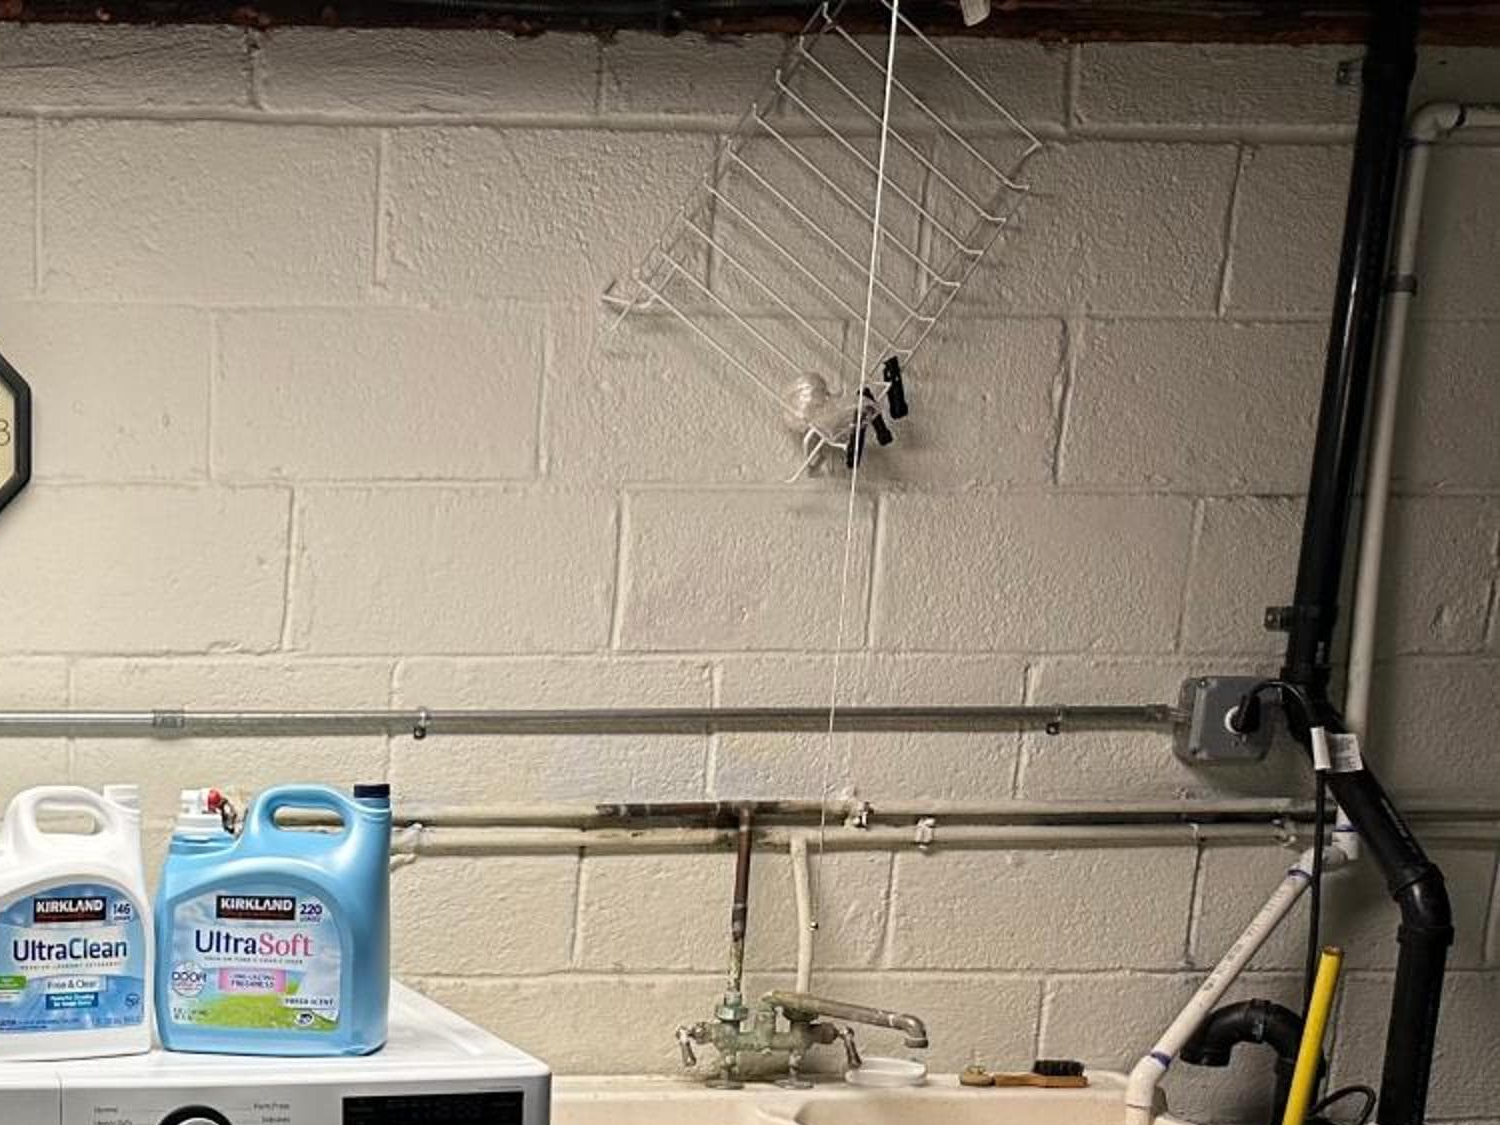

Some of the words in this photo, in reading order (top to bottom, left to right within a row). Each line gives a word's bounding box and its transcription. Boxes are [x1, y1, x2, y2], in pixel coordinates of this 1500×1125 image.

[35, 899, 104, 913] KIRKLAND
[112, 903, 132, 915] 146
[220, 897, 294, 911] KIRKLAND
[299, 903, 323, 915] 220
[12, 938, 127, 961] UltraClean
[195, 929, 315, 957] UltraSoft
